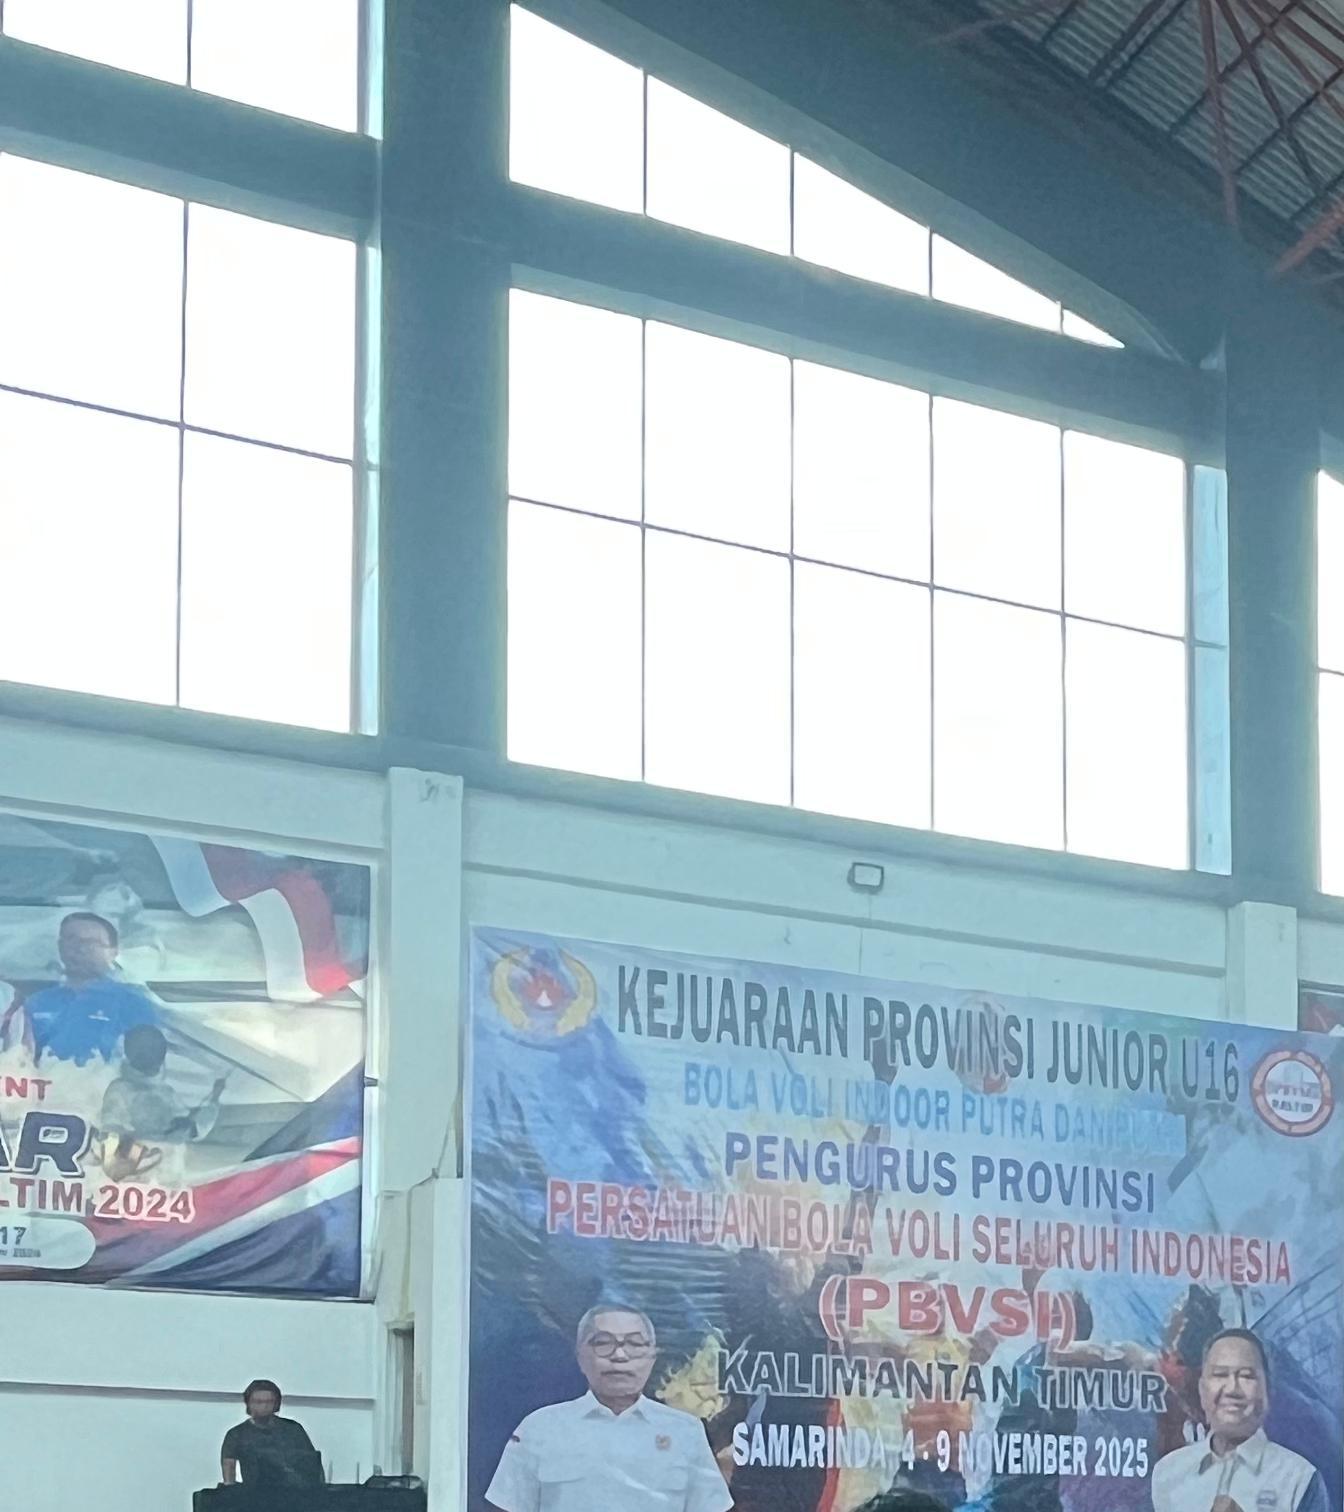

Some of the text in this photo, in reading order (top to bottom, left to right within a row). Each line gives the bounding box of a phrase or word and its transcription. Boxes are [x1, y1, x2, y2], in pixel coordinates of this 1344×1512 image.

[618, 965, 1240, 1103] KEJUARAAN PROVINSI JUNIOR U16
[0, 1075, 52, 1101] NT
[684, 1062, 757, 1110] BOLA
[771, 1071, 832, 1118] VOLI
[845, 1079, 950, 1132] INDOOR
[962, 1090, 1044, 1141] PUTRA
[1054, 1103, 1104, 1146] DAN
[0, 1111, 86, 1178] R
[725, 1132, 1154, 1214] PENGURUS PROVINSI
[0, 1177, 193, 1220] TIM 2024
[548, 1178, 1291, 1286] PERSATUAN BOLA VOLI SELURUH INDONESIA
[820, 1274, 1076, 1352] (PBVSI)
[717, 1349, 1168, 1413] KALIMANTAN TIMUR
[901, 1430, 914, 1471] 4
[936, 1430, 950, 1472] 9
[959, 1430, 1087, 1476] NOVEMBER
[1095, 1438, 1149, 1478] 2025
